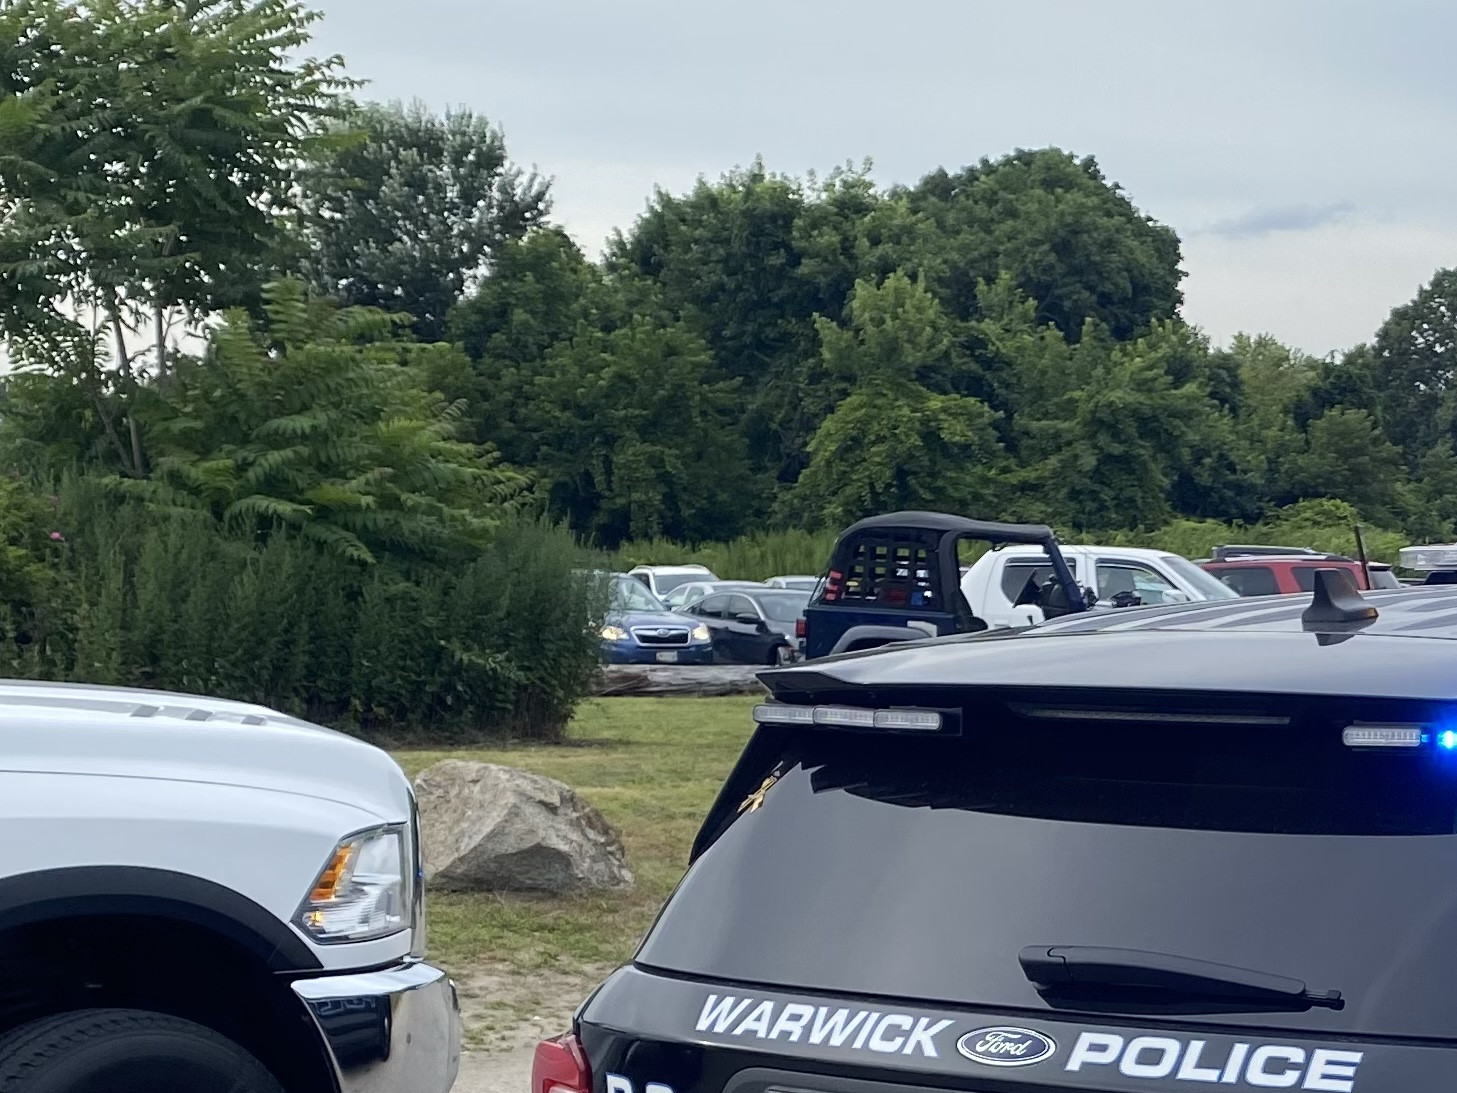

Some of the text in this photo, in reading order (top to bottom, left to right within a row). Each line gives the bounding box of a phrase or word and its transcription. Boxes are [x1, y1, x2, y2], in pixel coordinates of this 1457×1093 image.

[694, 993, 1364, 1093] WARWICK POLICE
[975, 1030, 1033, 1057] Ford
